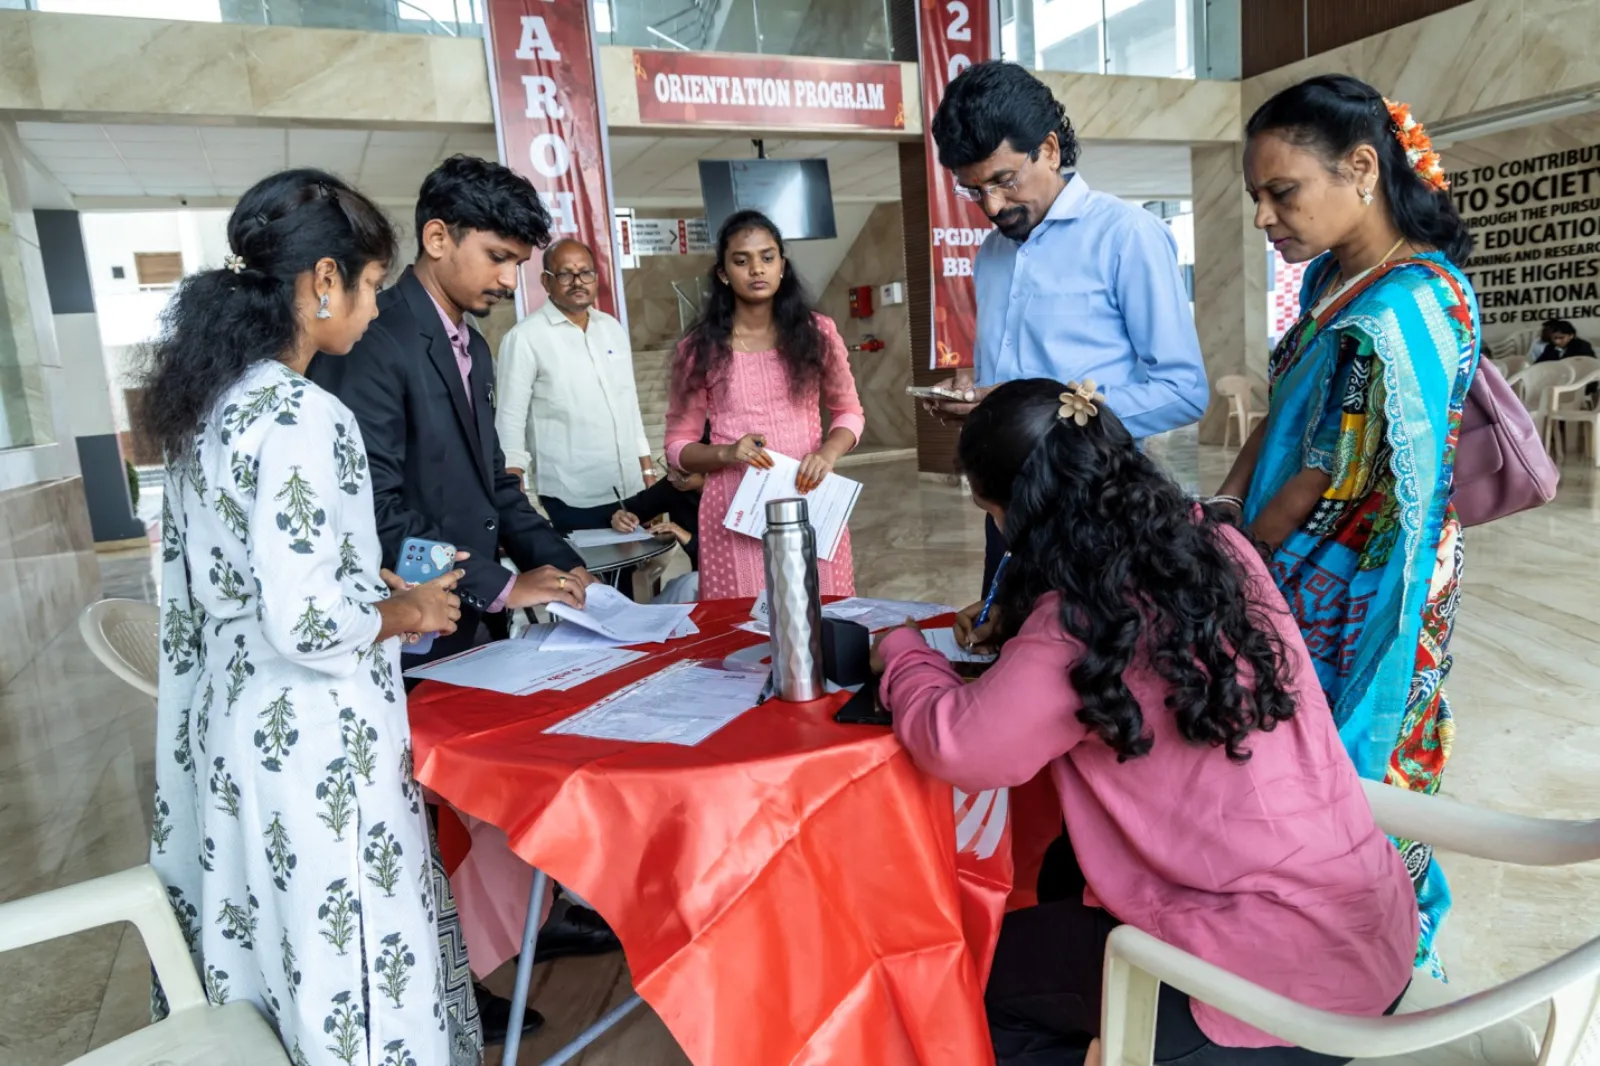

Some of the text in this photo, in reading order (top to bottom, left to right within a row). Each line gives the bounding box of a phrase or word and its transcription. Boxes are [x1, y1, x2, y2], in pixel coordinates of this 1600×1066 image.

[654, 73, 885, 110] ORIENTATION PROGRAM
[515, 0, 578, 233] AROH
[1472, 166, 1495, 184] TO
[1453, 187, 1489, 214] TO
[1521, 206, 1548, 221] THE
[1485, 216, 1600, 250] EDUCATIO
[942, 256, 974, 277] BB
[1465, 253, 1511, 268] ARNING
[1514, 249, 1541, 262] AND
[1480, 267, 1516, 288] THE
[1500, 311, 1518, 323] OF
